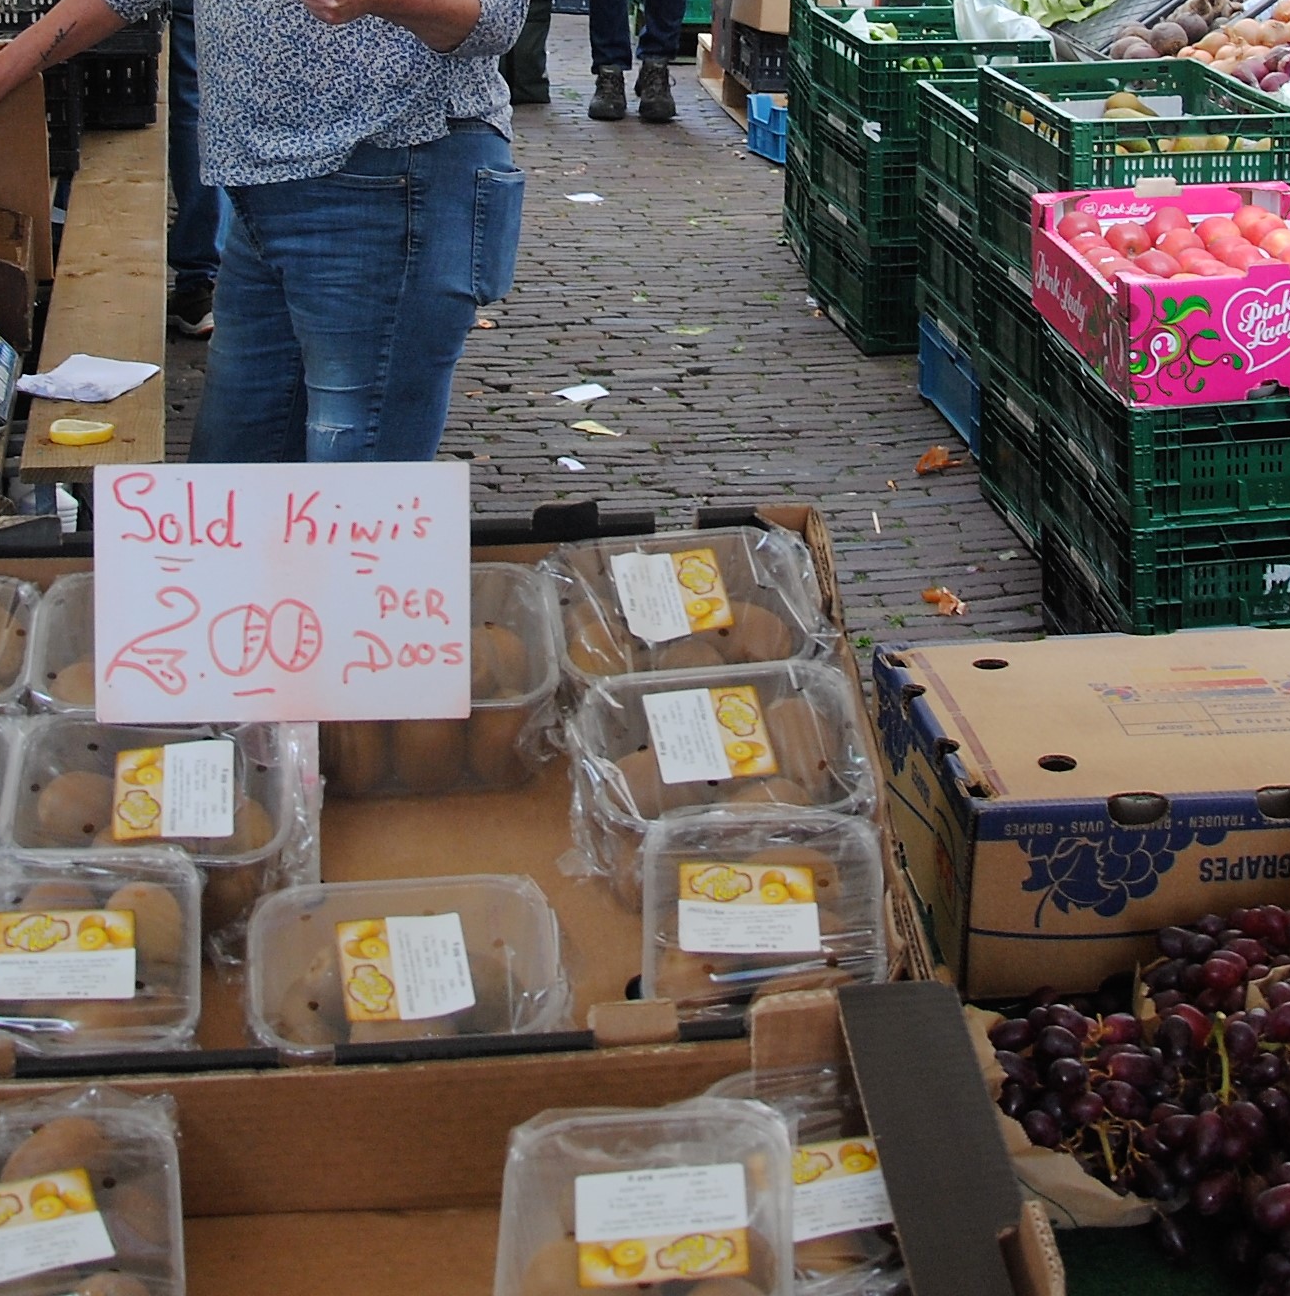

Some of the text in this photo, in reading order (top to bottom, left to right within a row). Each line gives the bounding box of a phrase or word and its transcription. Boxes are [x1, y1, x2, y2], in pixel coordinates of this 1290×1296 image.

[1035, 250, 1088, 333] Pink Lady
[284, 491, 432, 545] Kiwi's
[104, 585, 450, 695] 2.00 PER
[1004, 822, 1053, 836] GRAPES
[1070, 820, 1104, 833] UVAS
[1189, 815, 1245, 828] TRAUBEN
